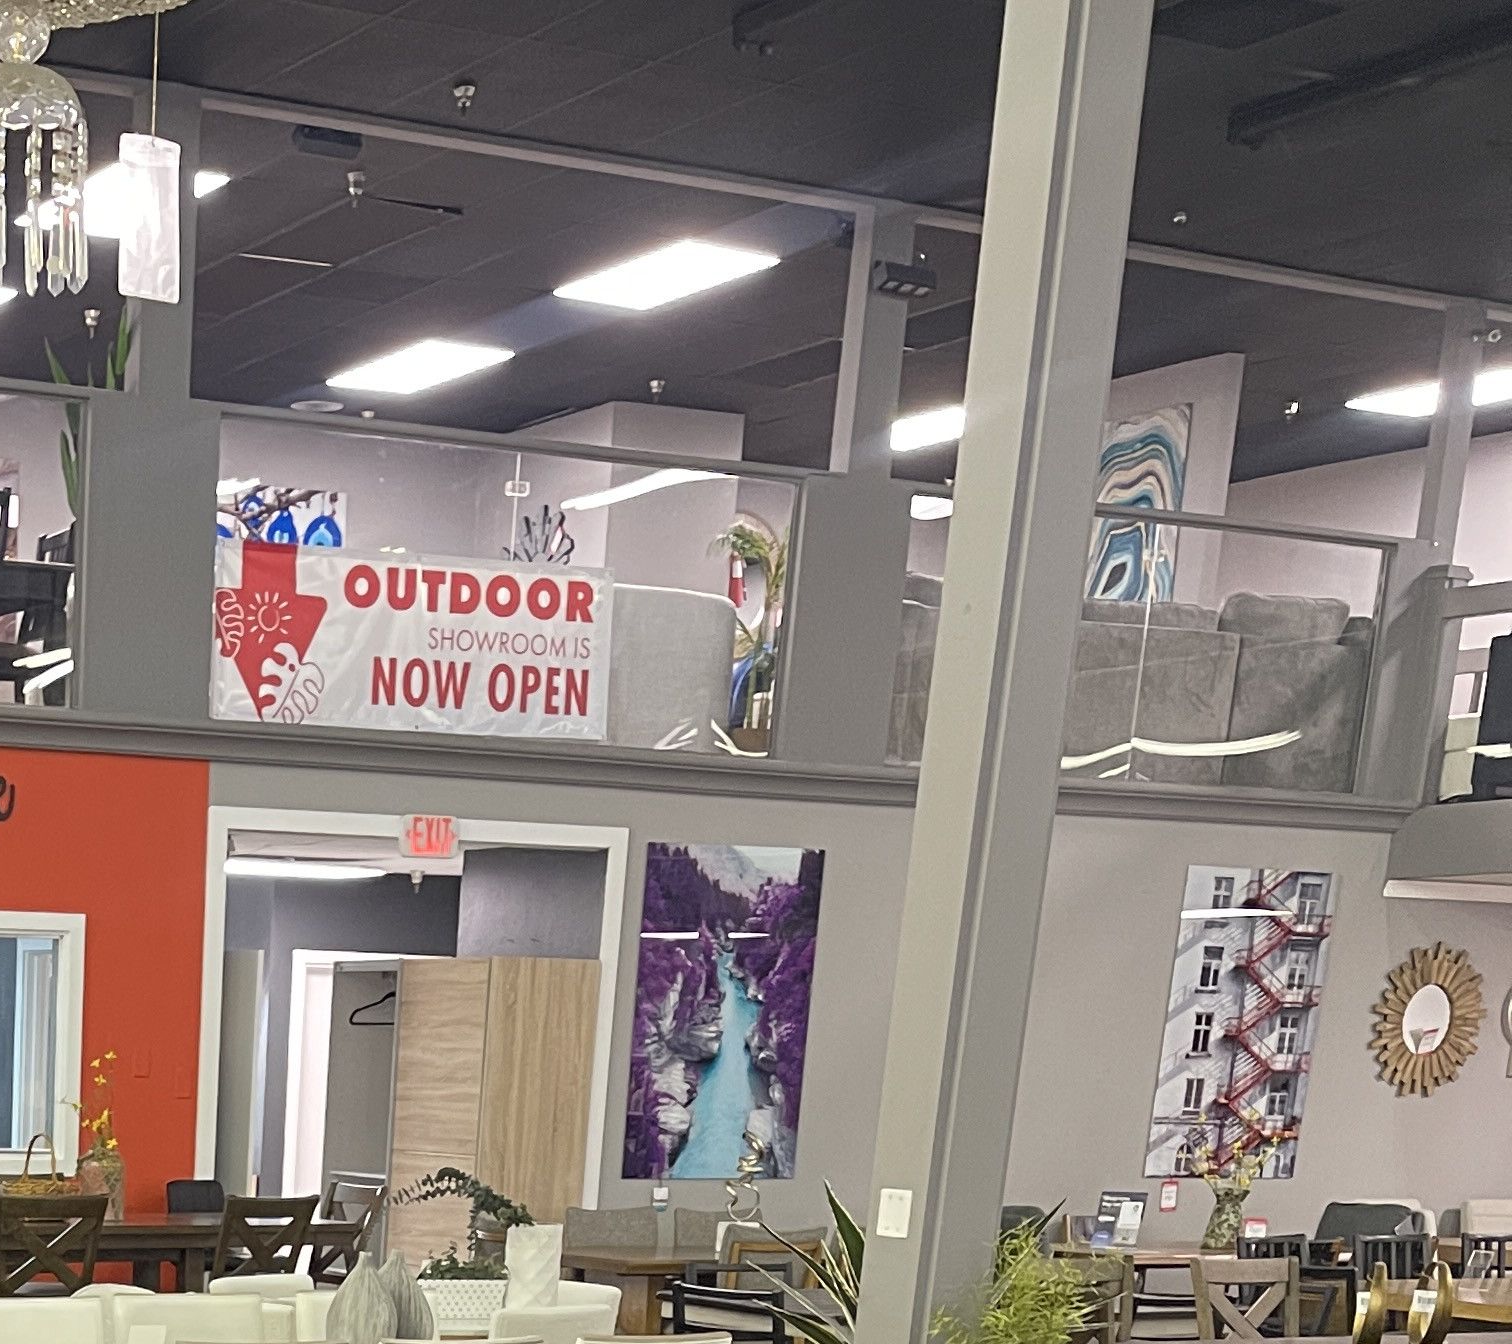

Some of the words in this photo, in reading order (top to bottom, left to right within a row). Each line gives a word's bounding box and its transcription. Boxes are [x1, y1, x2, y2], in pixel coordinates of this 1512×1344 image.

[343, 563, 594, 623] OUTDOOR
[427, 627, 567, 659] SHOWROOM
[573, 636, 591, 660] IS
[370, 656, 472, 710] NOW
[487, 662, 590, 717] OPEN
[411, 816, 453, 855] EXIT
